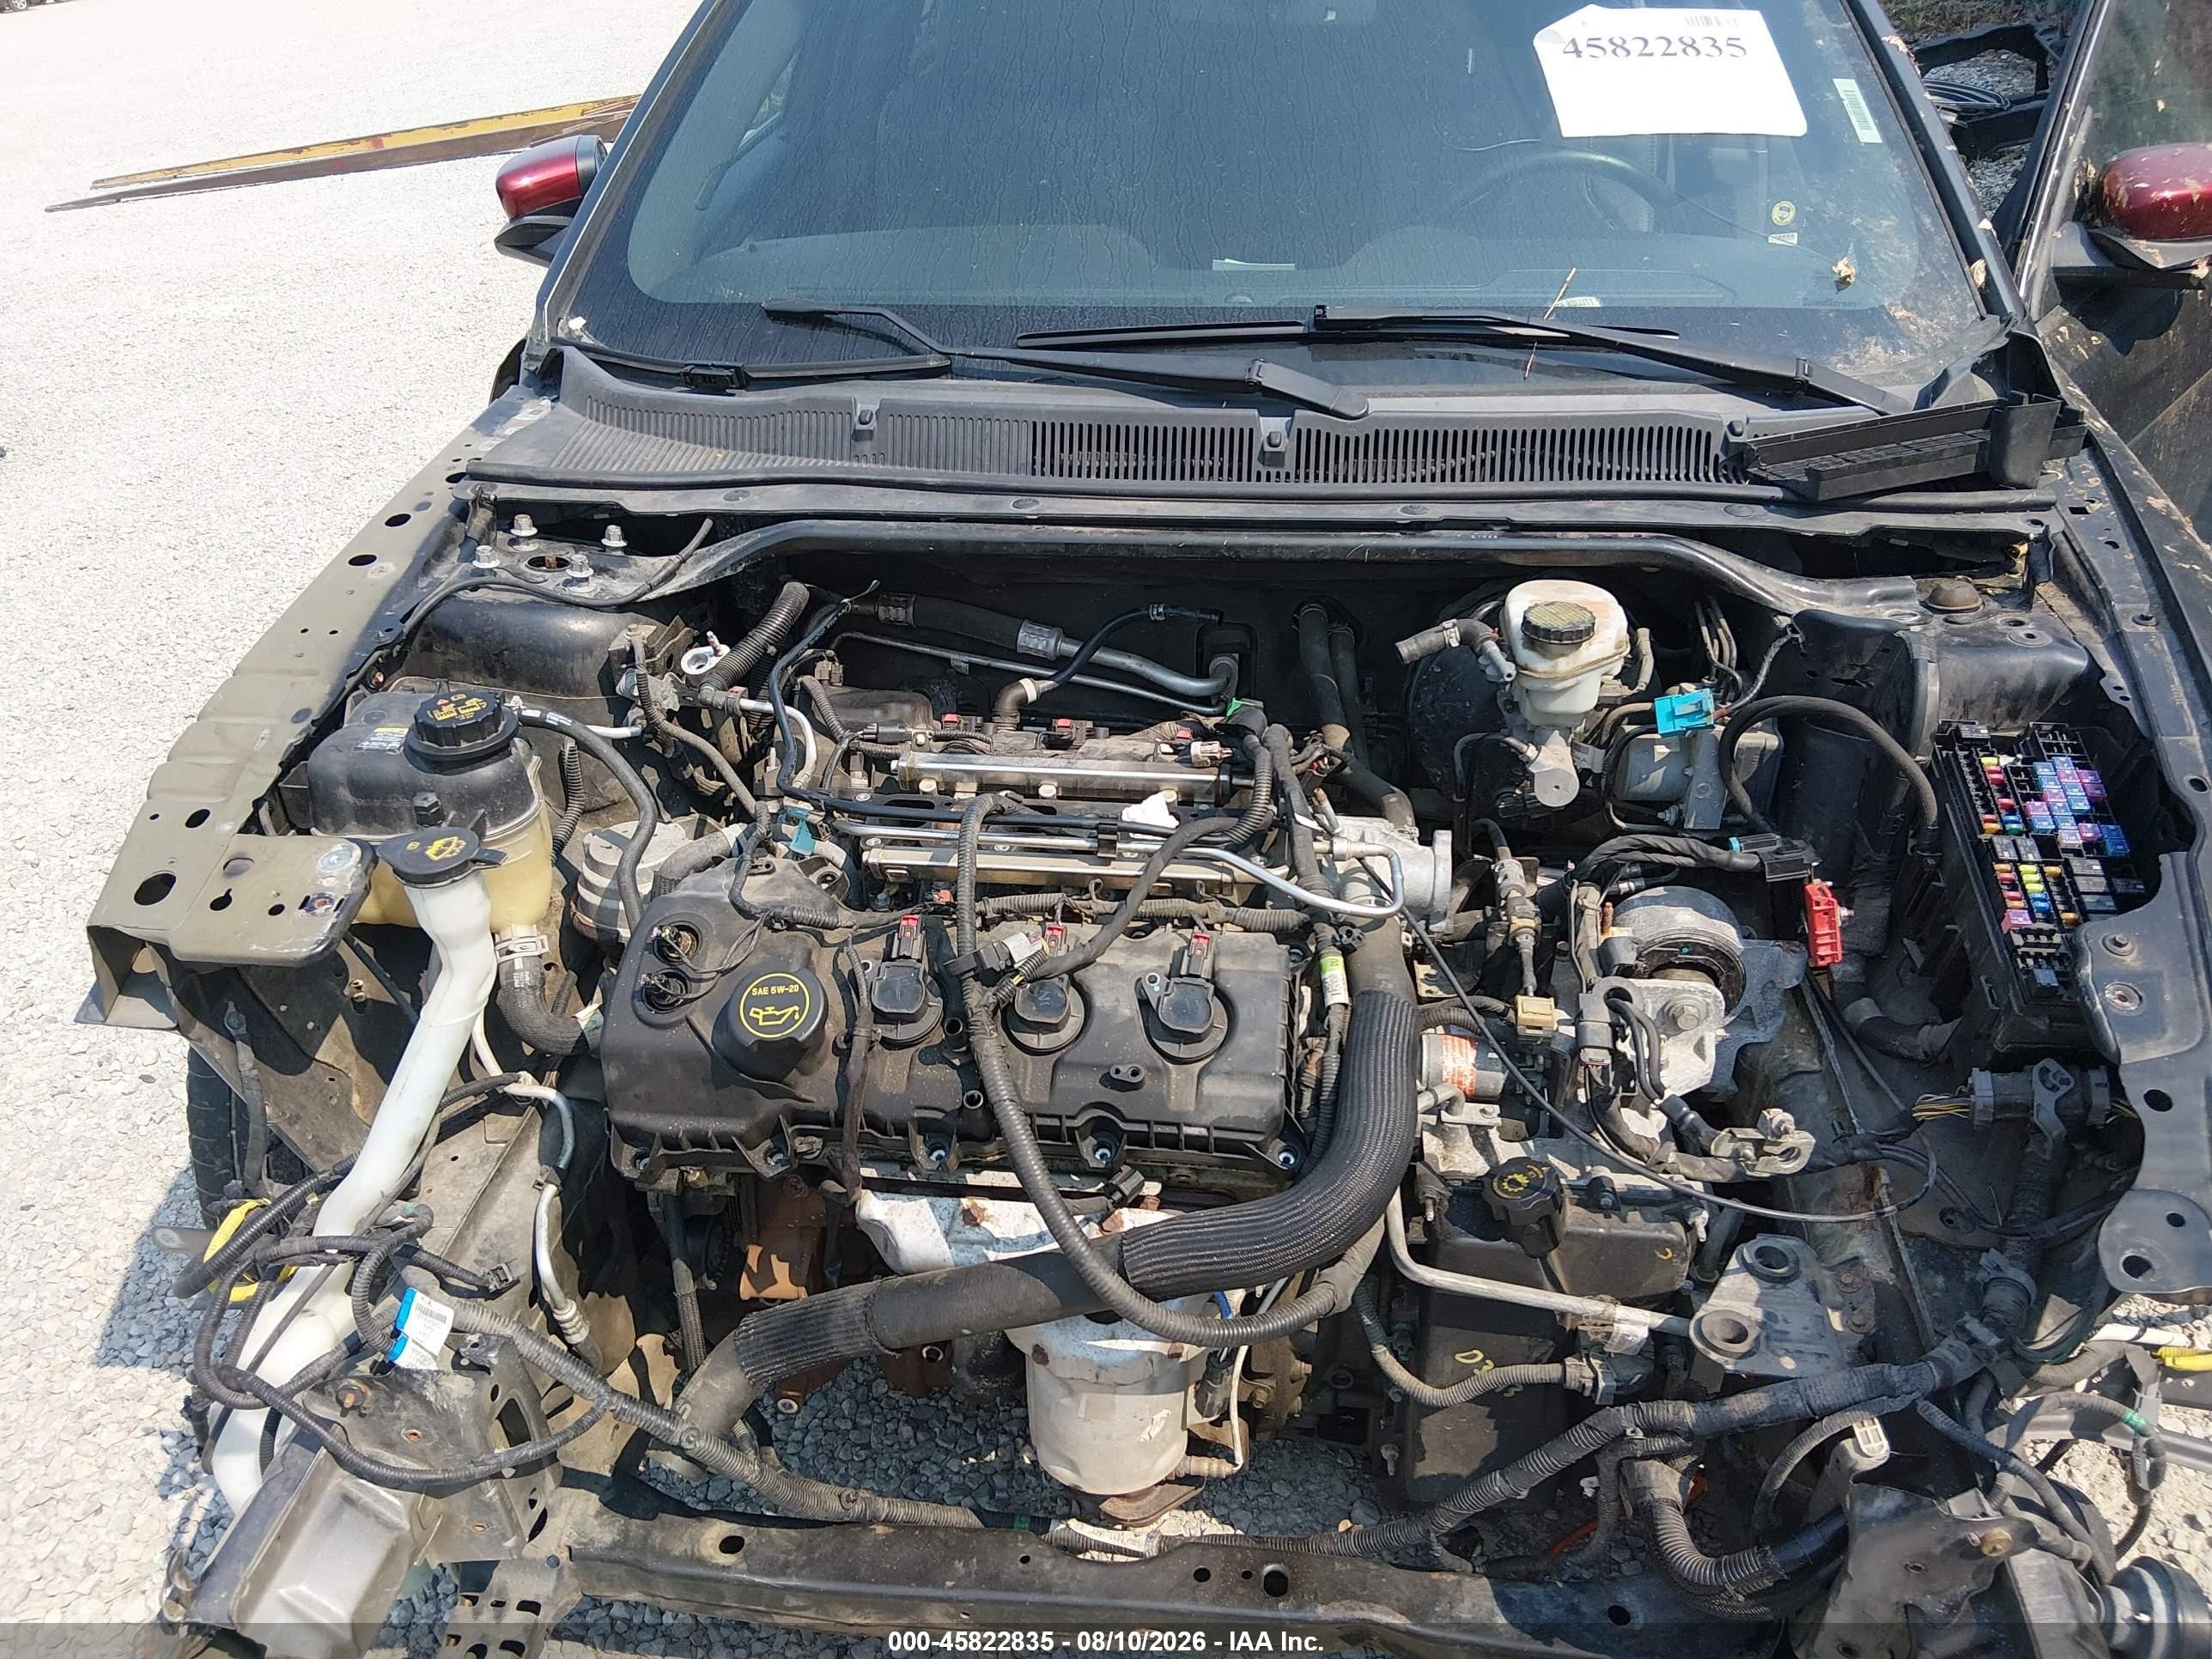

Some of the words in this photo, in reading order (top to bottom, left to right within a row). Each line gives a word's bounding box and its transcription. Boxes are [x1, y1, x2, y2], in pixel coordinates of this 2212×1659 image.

[1562, 35, 1747, 59] 45822835
[751, 987, 769, 996] SAE
[771, 984, 799, 994] 5W-20
